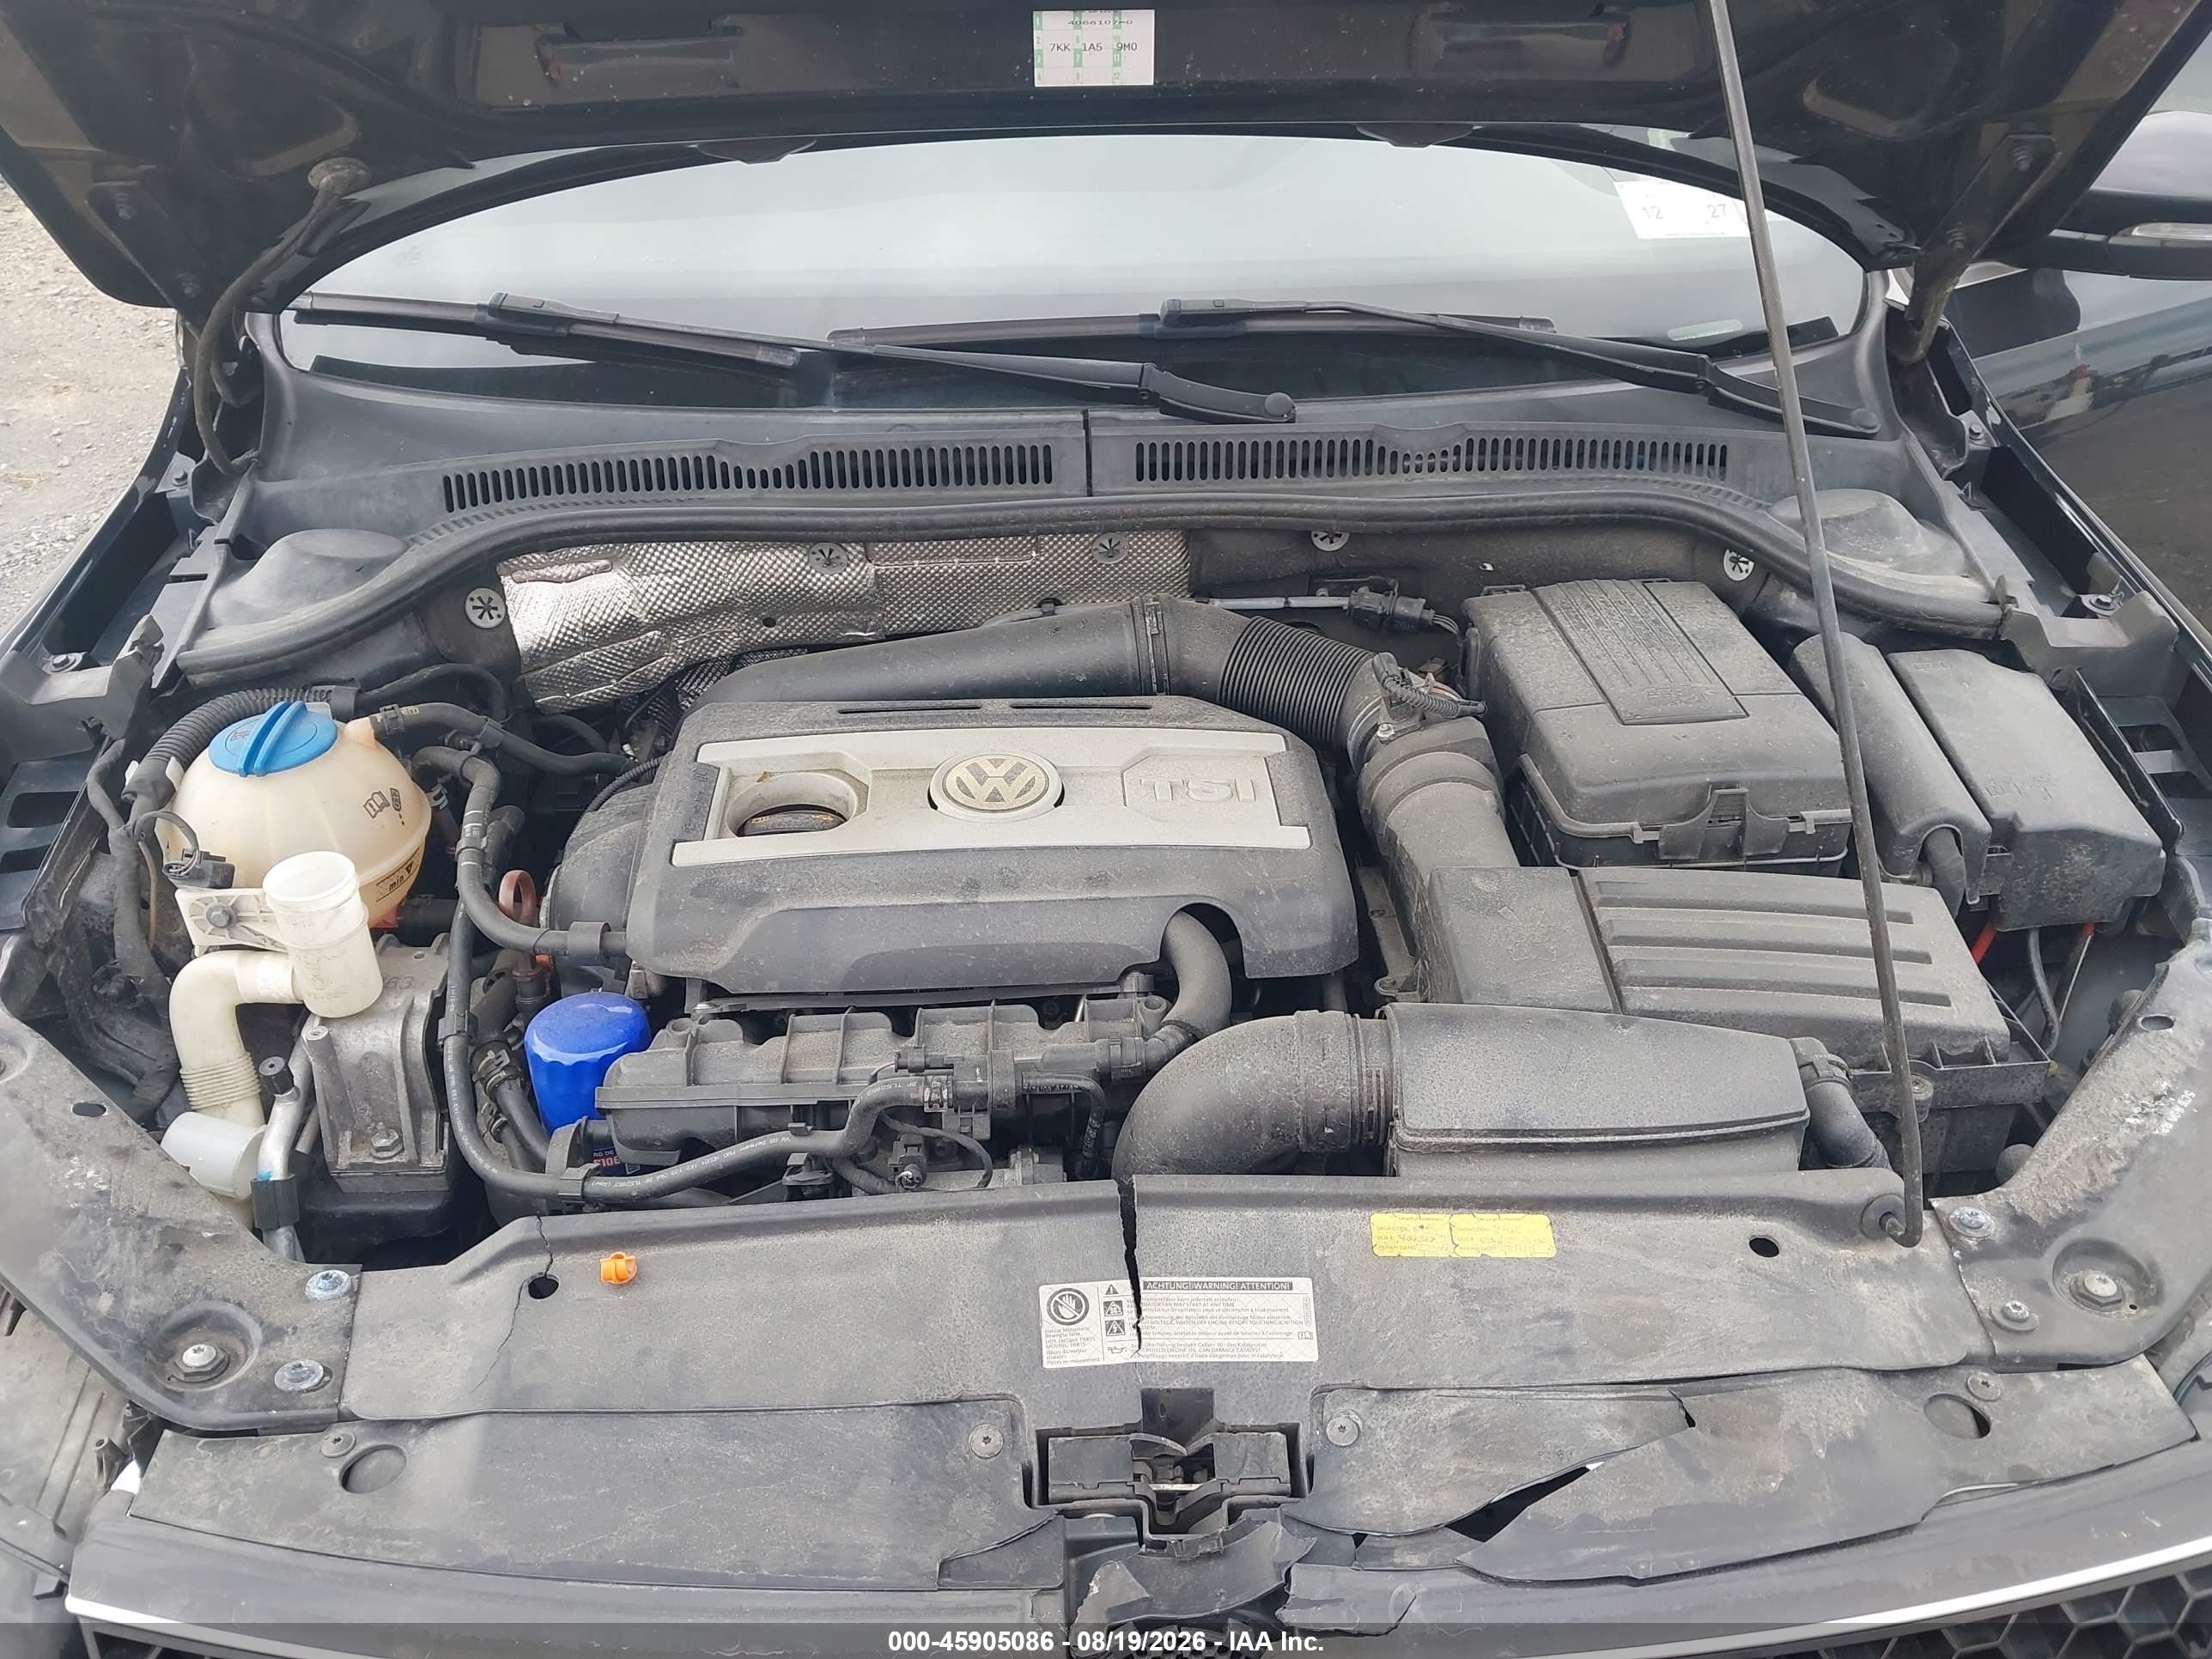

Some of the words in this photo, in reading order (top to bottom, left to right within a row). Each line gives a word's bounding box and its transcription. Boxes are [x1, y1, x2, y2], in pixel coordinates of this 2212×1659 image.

[1050, 43, 1071, 52] 7KK
[1082, 43, 1103, 52] 1A5
[1642, 205, 1664, 220] 12
[1707, 204, 1727, 218] 27
[1139, 778, 1257, 802] TSI
[388, 875, 405, 893] min
